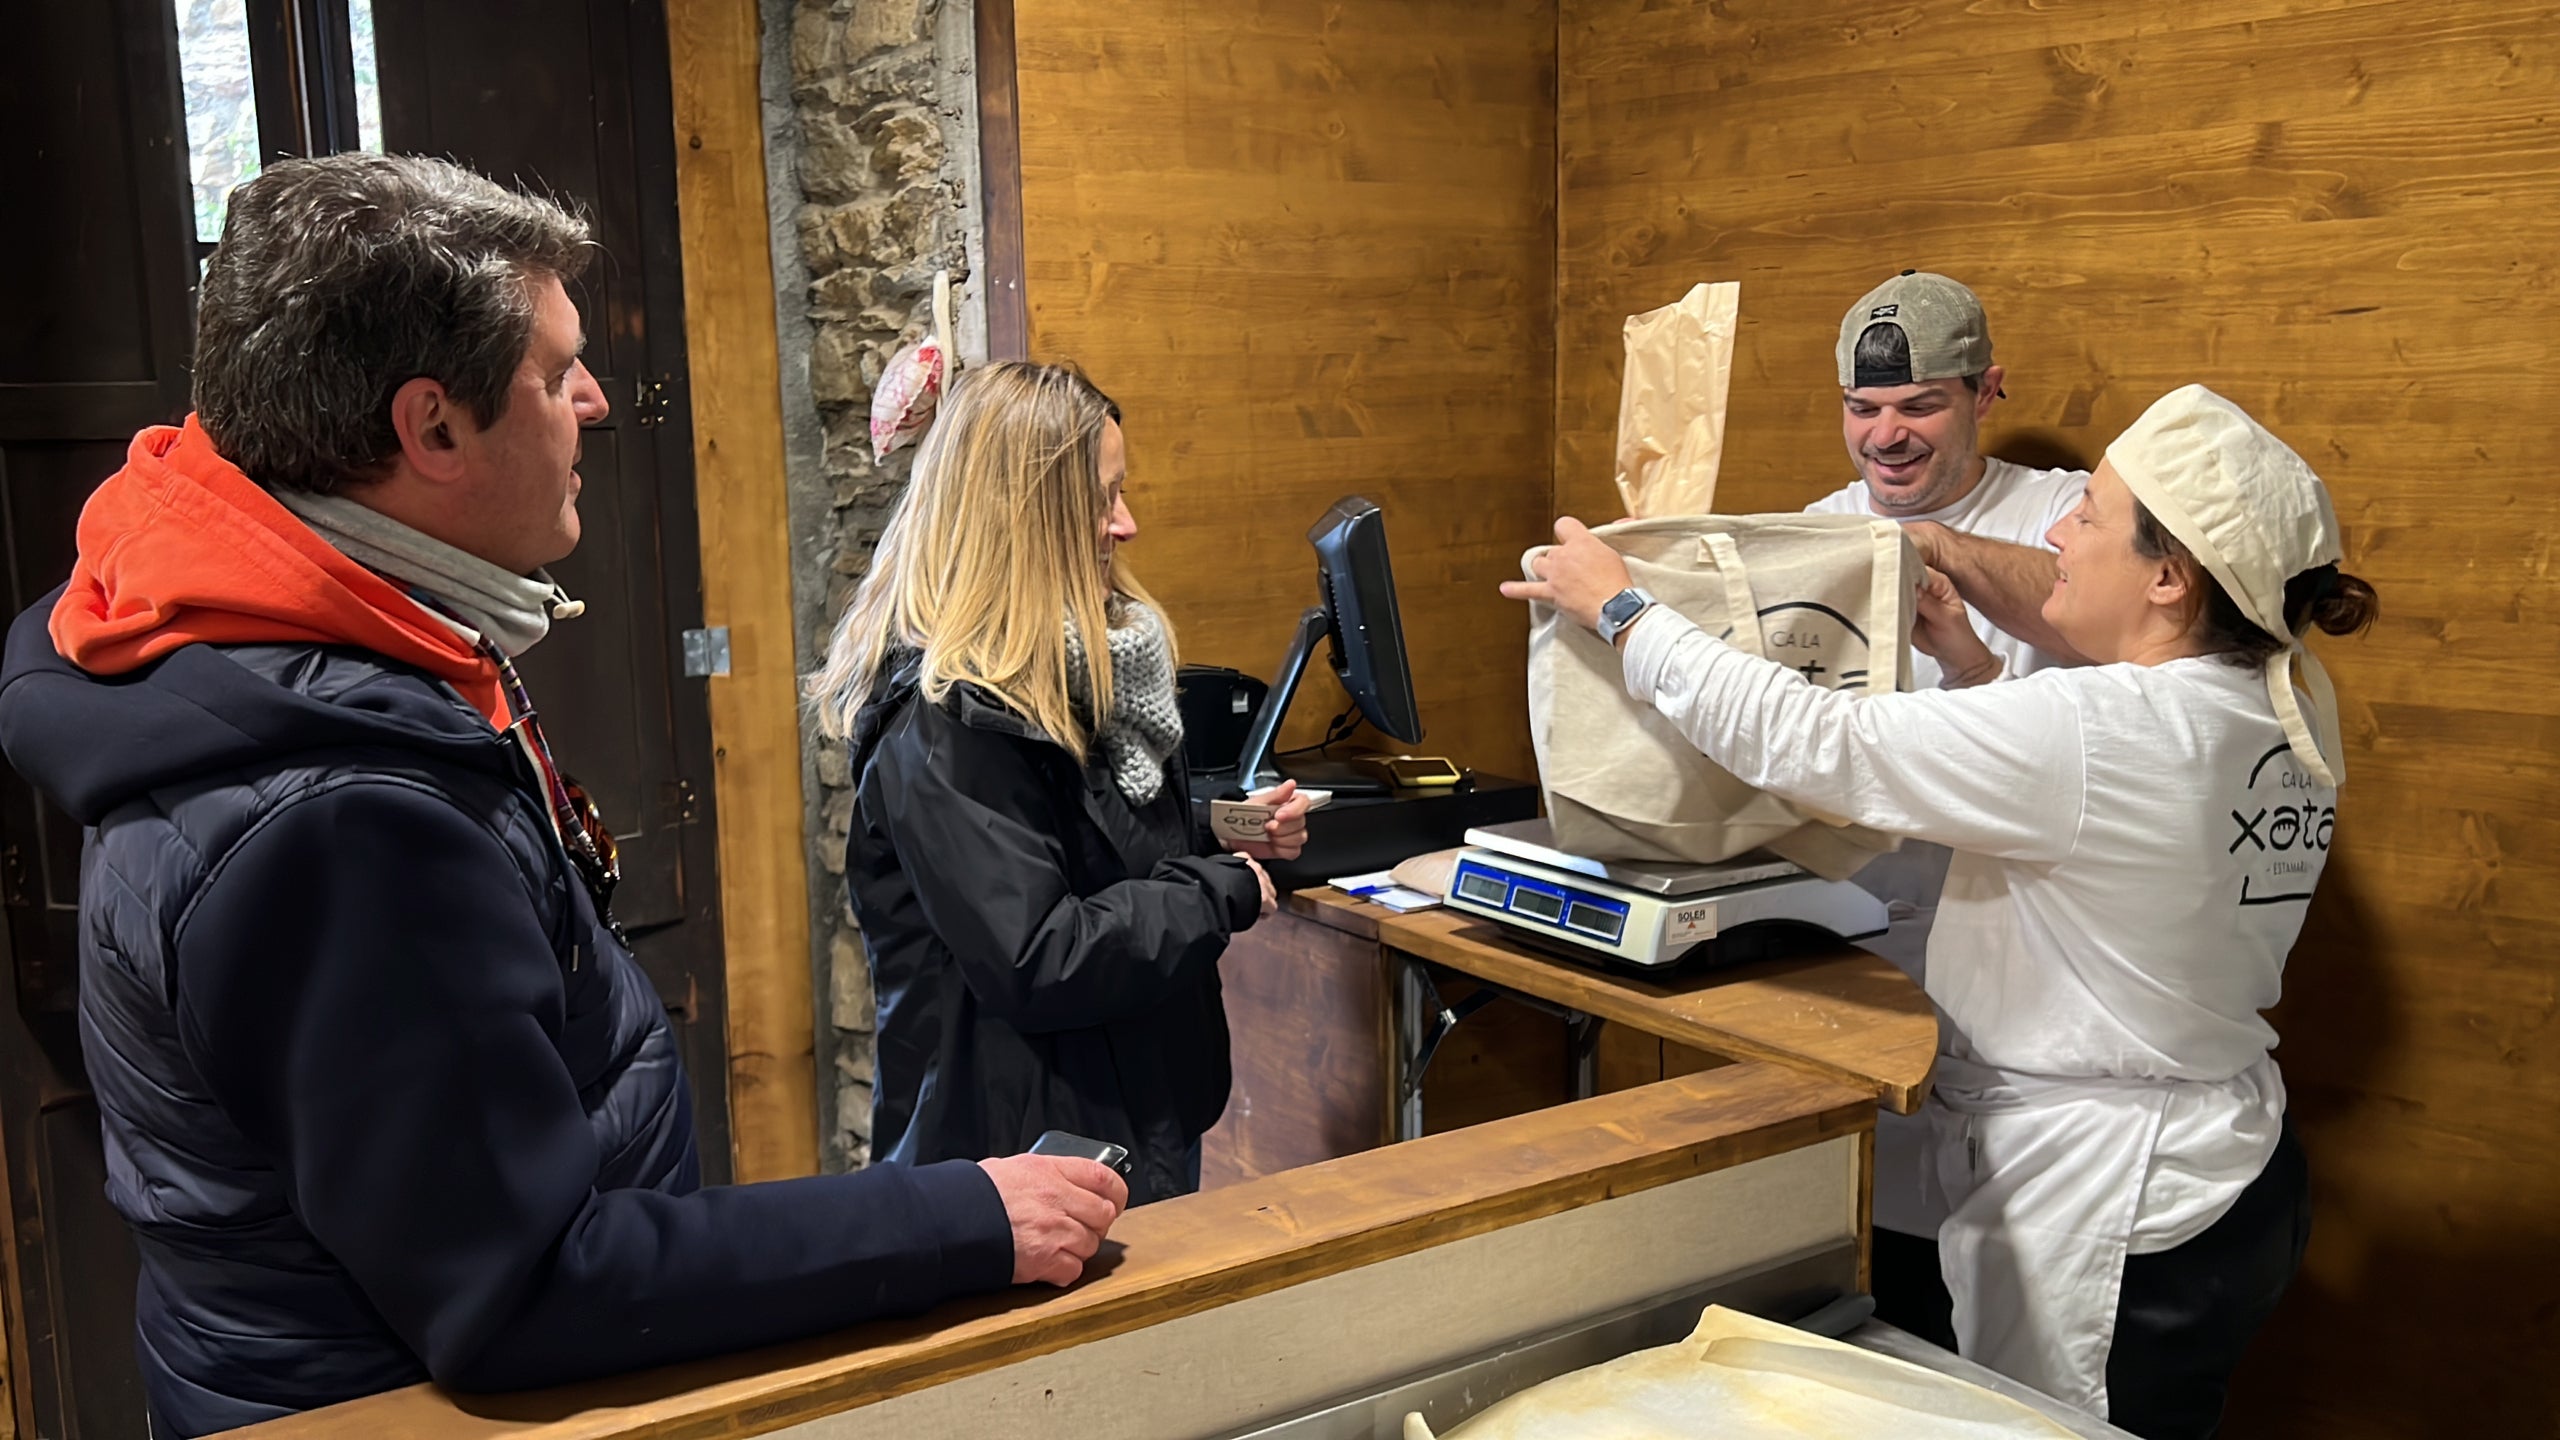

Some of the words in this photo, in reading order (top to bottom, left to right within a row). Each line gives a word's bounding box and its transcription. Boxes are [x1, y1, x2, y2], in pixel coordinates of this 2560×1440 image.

[1771, 631, 1795, 648] CA
[1801, 631, 1820, 648] LA
[2282, 772, 2296, 789] CA
[2299, 772, 2312, 789] LA
